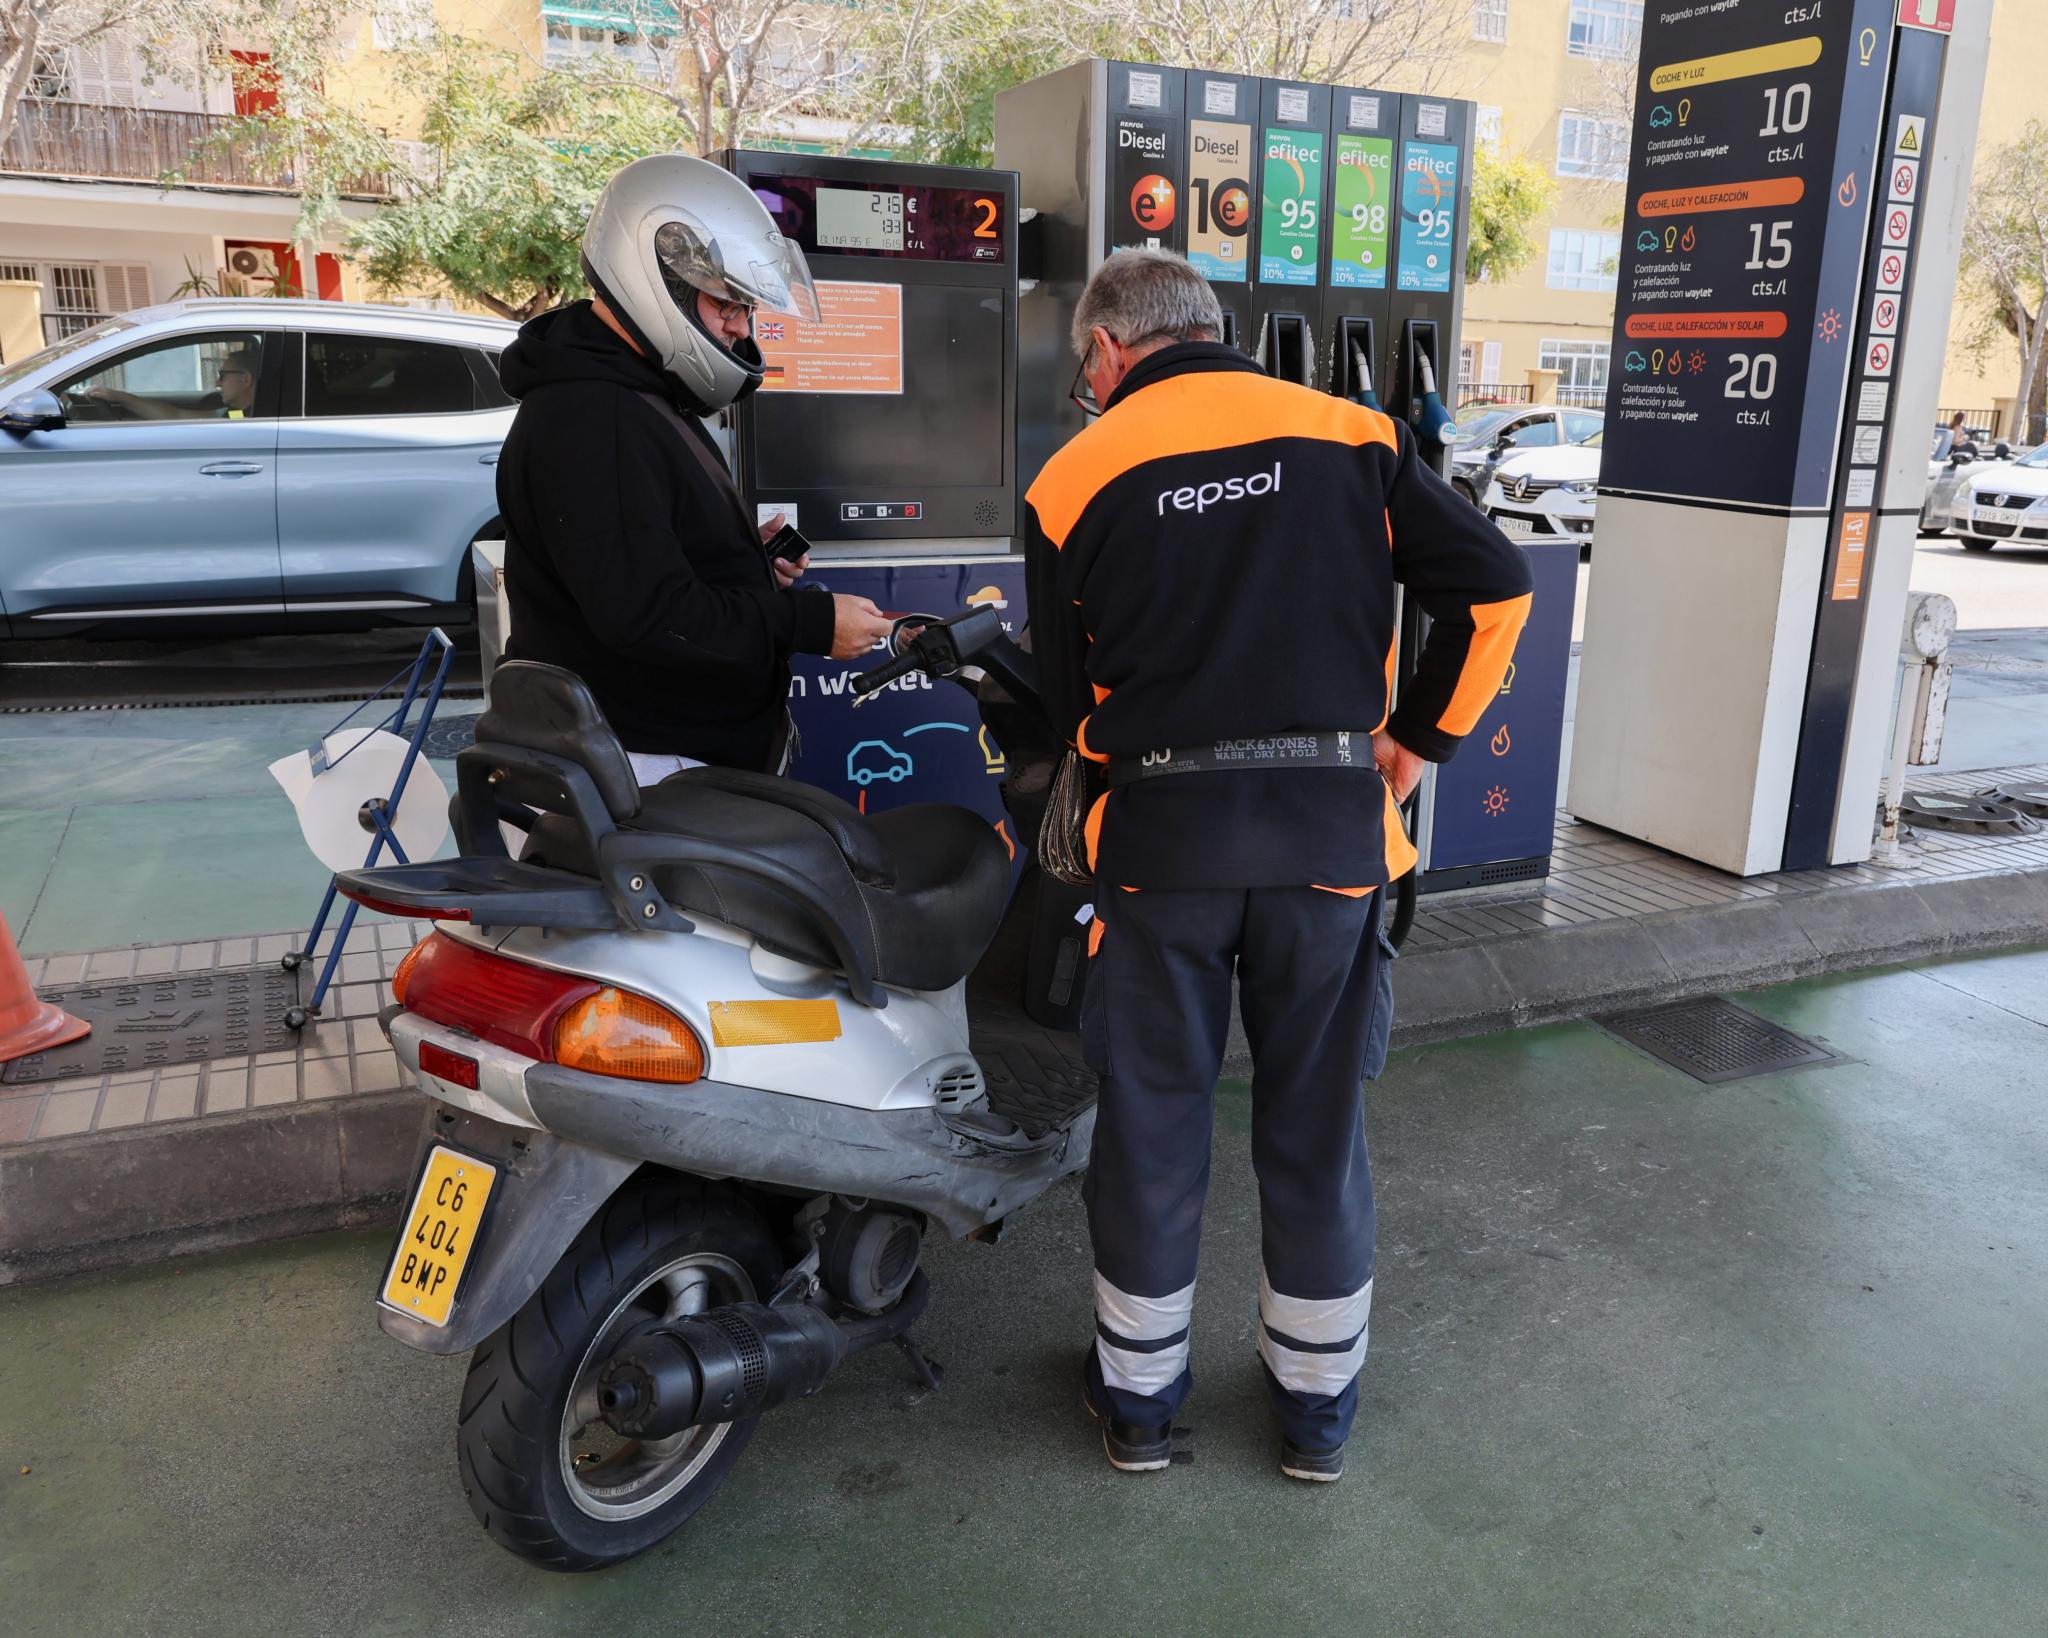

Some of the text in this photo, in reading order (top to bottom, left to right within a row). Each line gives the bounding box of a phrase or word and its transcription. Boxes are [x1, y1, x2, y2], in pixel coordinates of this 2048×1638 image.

[1660, 7, 1693, 24] Pagando
[1694, 5, 1709, 15] con
[1784, 1, 1822, 25] cts./l
[1656, 67, 1705, 85] COCHE Y LUZ
[1759, 83, 1811, 137] 10
[1120, 129, 1165, 150] Diesel
[1195, 136, 1238, 156] Diesel
[1647, 134, 1706, 151] Contratando luz
[1268, 144, 1320, 163] efitec
[1340, 150, 1390, 168] efitec
[1646, 156, 1651, 167] y
[1652, 151, 1684, 166] pagando
[1684, 150, 1699, 160] con
[1768, 142, 1804, 163] cts./l
[1407, 156, 1455, 175] efitec
[907, 198, 918, 214] €
[1643, 190, 1749, 210] COCHE, LUZ Y CALEFACCIÓN
[974, 198, 998, 238] 2
[1280, 198, 1316, 230] 95
[1352, 204, 1386, 234] 98
[1417, 208, 1450, 238] 95
[908, 221, 914, 234] L
[1745, 221, 1793, 270] 15
[1264, 269, 1284, 280] 10%
[1634, 262, 1692, 274] Contratando luz
[1336, 272, 1355, 283] 10%
[1402, 276, 1420, 287] 10%
[1634, 275, 1680, 289] y calefacción
[1632, 292, 1637, 302] y
[1638, 288, 1668, 301] pagando
[1670, 290, 1684, 298] con
[1752, 279, 1787, 296] cts./l
[1630, 321, 1657, 332] COCHE,
[1676, 318, 1728, 331] CALEFACCIÓN
[1729, 320, 1736, 330] Y
[1737, 320, 1764, 330] SOLAR
[1724, 353, 1778, 400] 20
[1622, 383, 1679, 396] Contratando luz,
[1622, 396, 1686, 408] calefacción y solar
[1620, 410, 1624, 420] y
[1626, 409, 1656, 420] pagando
[1657, 411, 1670, 420] con
[1736, 410, 1770, 426] cts./l
[1158, 461, 1281, 516] repsol
[1214, 736, 1318, 752] JACK&JONES
[1336, 732, 1350, 746] W
[1254, 750, 1275, 760] DRY
[1290, 748, 1319, 758] FOLD
[1338, 750, 1352, 762] 75
[436, 1176, 468, 1212] C6
[415, 1214, 460, 1257] 404
[401, 1253, 447, 1296] BMP
